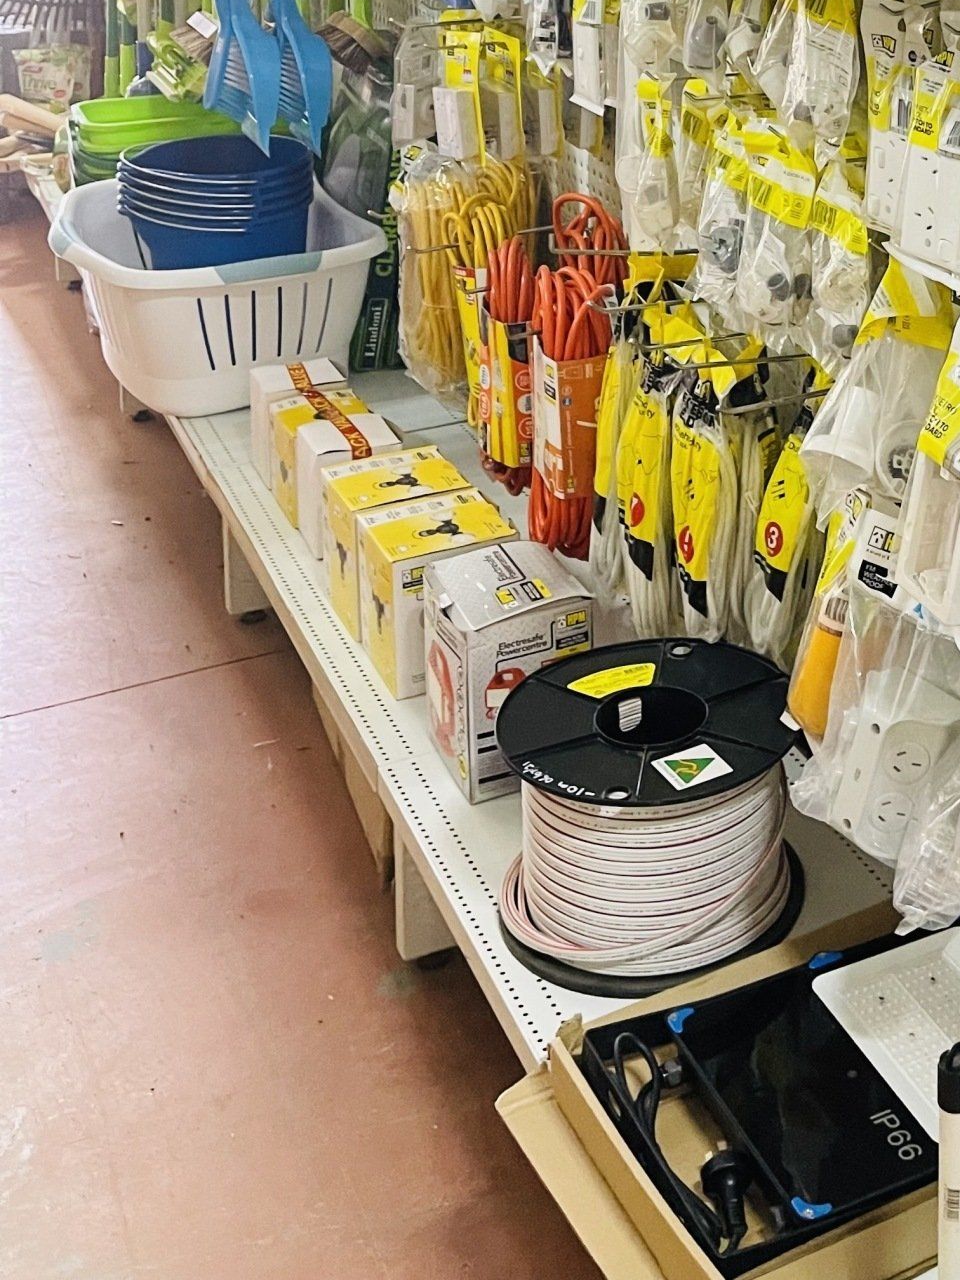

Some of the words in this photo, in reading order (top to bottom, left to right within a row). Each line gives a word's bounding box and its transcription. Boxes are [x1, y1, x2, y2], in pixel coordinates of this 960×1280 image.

[364, 306, 382, 357] Lindoni
[767, 526, 780, 548] 3
[566, 610, 587, 627] HPM
[496, 641, 548, 658] Powercentre
[498, 633, 545, 651] Electresafe
[870, 1108, 923, 1161] IP66
